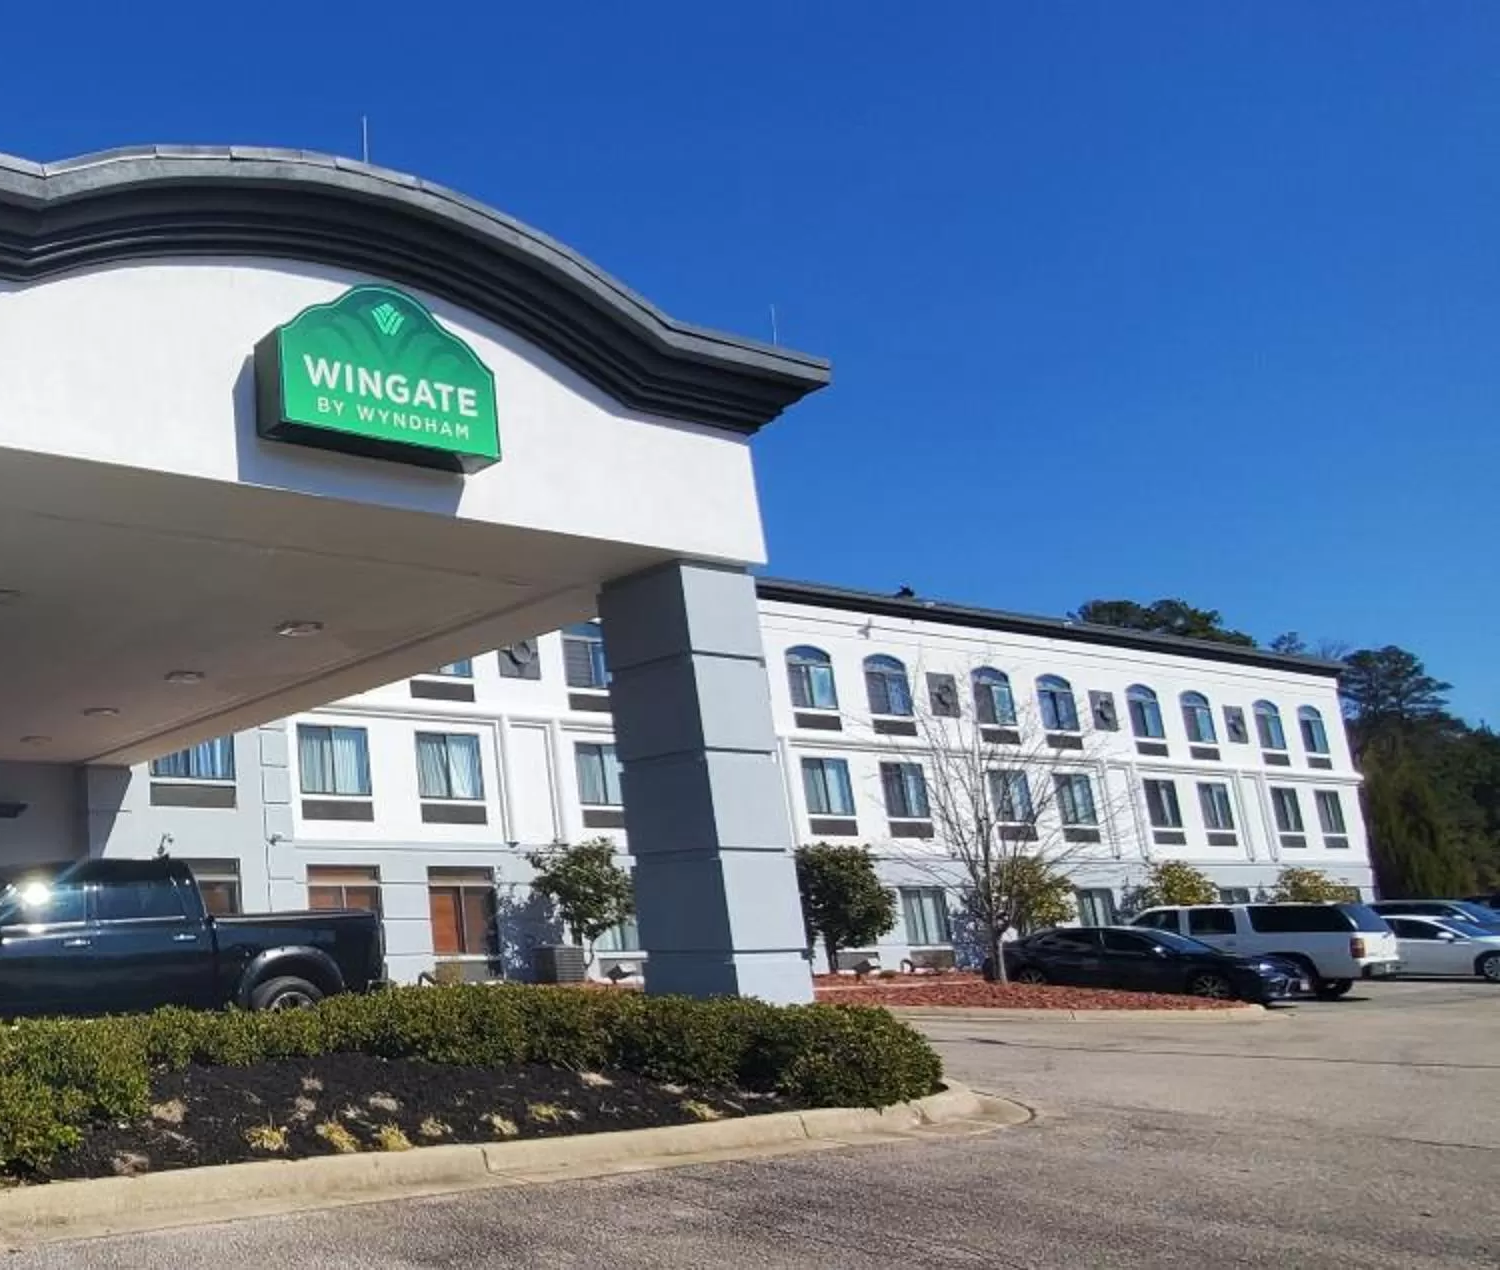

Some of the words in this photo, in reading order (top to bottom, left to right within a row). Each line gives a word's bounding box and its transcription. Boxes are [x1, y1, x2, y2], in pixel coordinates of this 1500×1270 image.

[303, 354, 479, 417] WINGATE
[317, 397, 345, 416] BY
[356, 405, 470, 440] WYNDHAM
